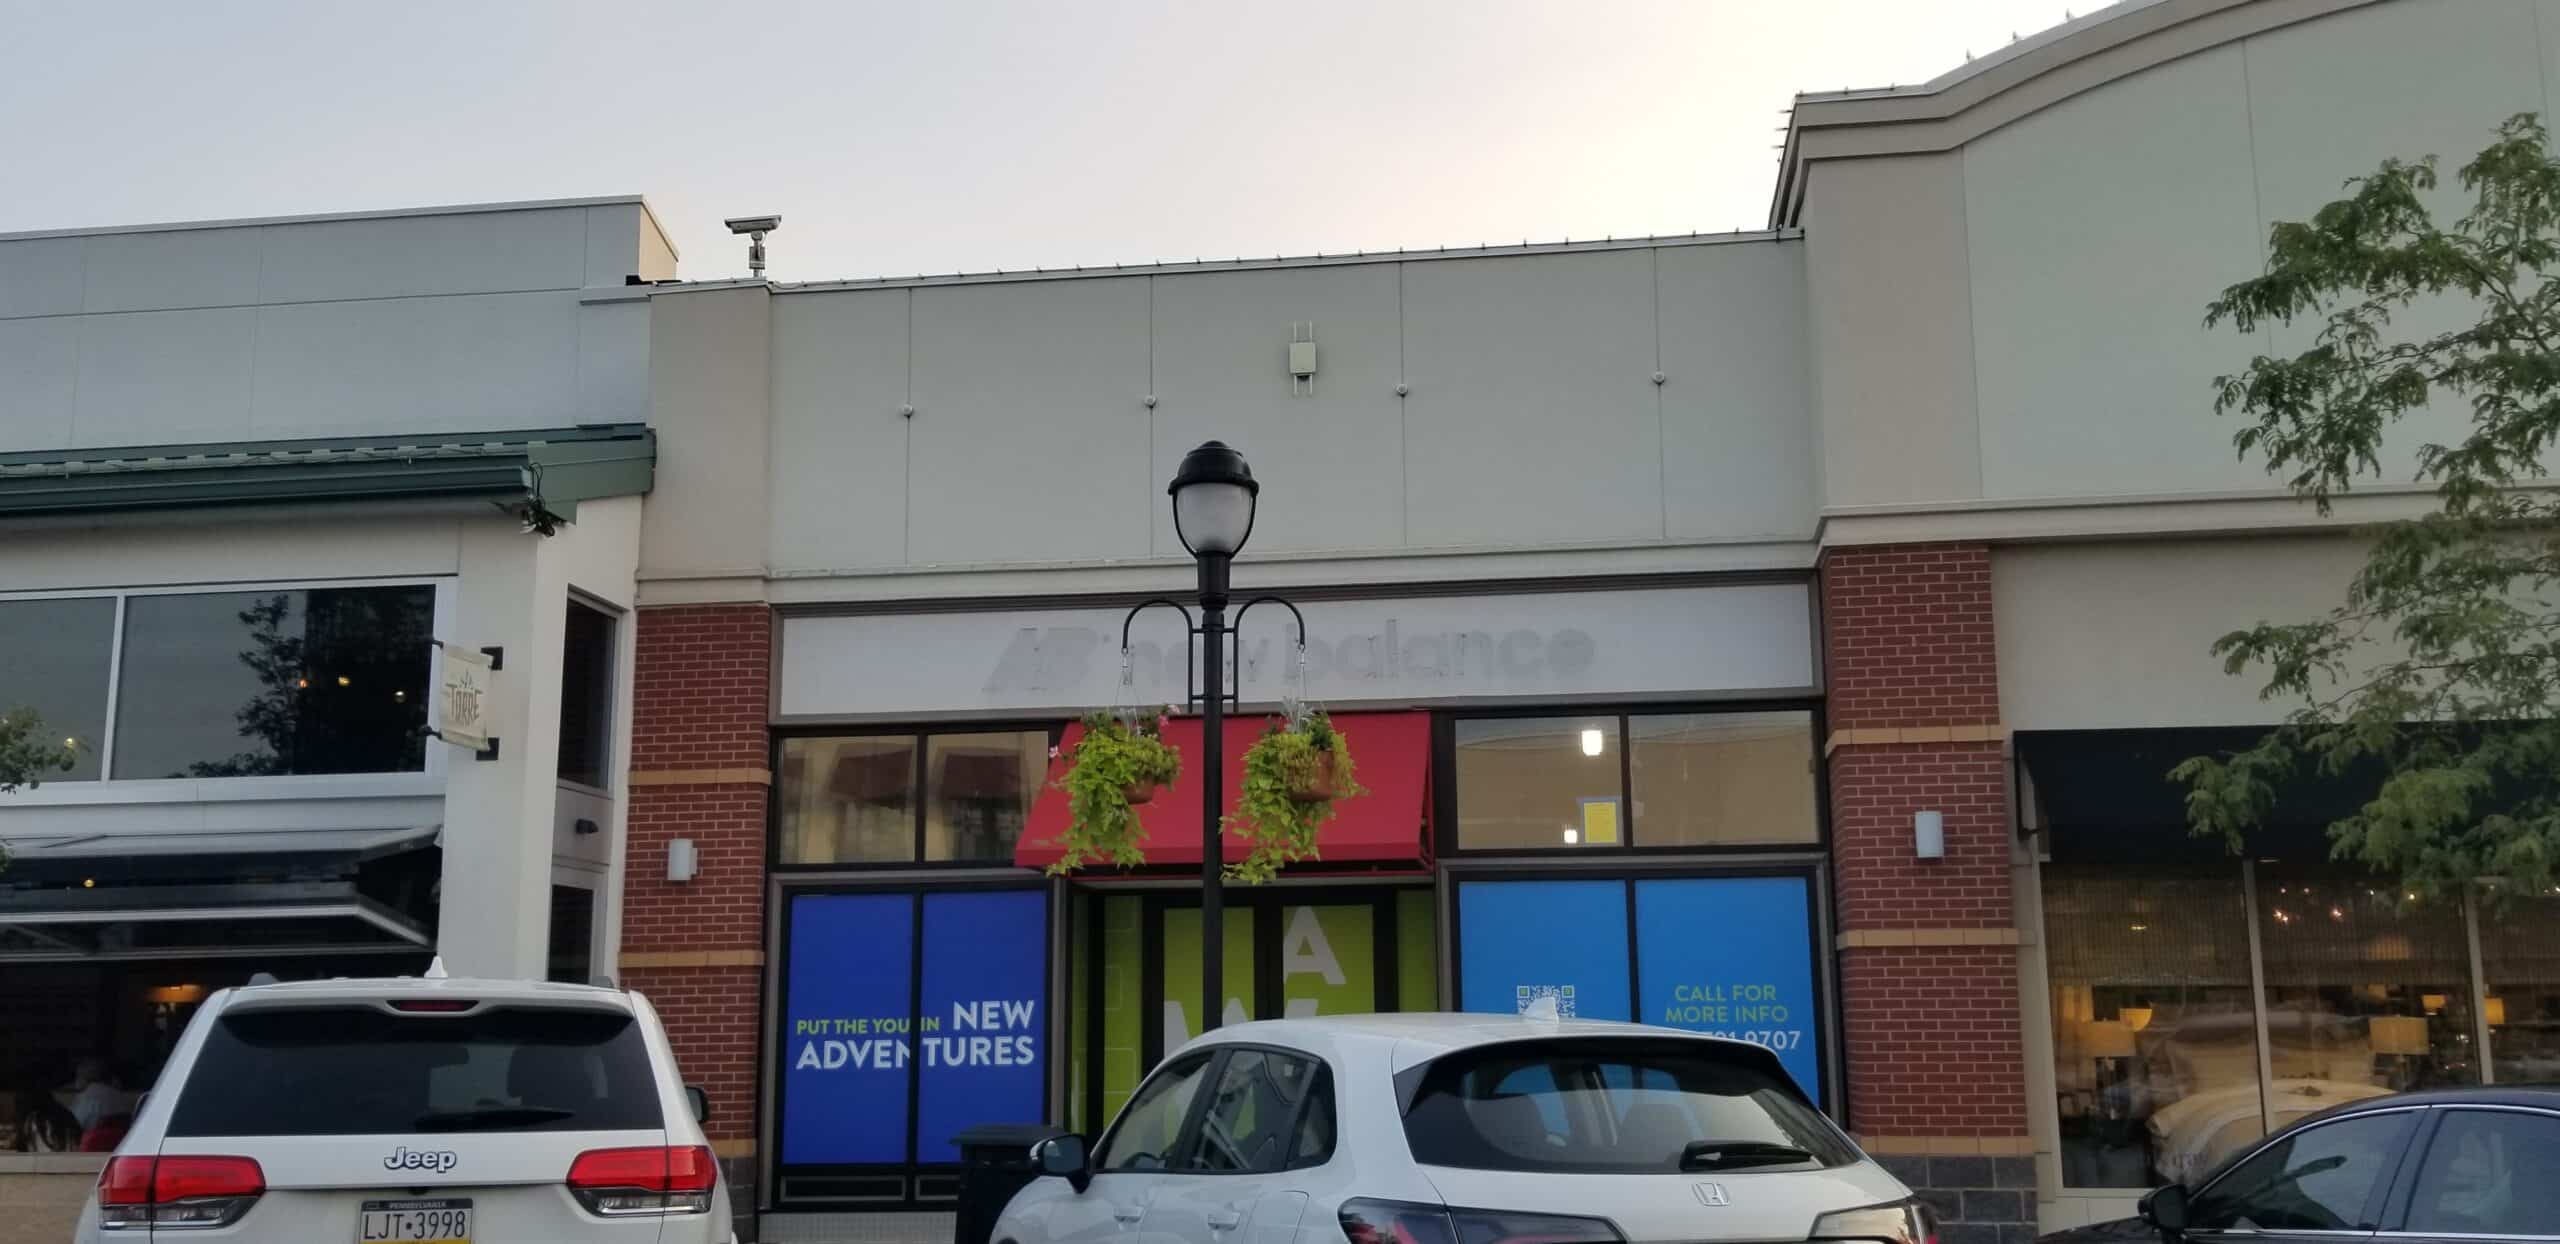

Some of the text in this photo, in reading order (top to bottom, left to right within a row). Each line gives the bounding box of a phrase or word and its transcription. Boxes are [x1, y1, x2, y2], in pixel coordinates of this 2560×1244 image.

[1285, 618, 1595, 683] balance
[446, 683, 483, 728] TORRE
[1674, 984, 1777, 1001] CALL FOR
[796, 1000, 1035, 1034] PUT THE YOU IN NEW
[1665, 1005, 1788, 1023] MORE INFO
[796, 1036, 1035, 1070] ADVENTURES
[384, 1146, 457, 1174] Jeep
